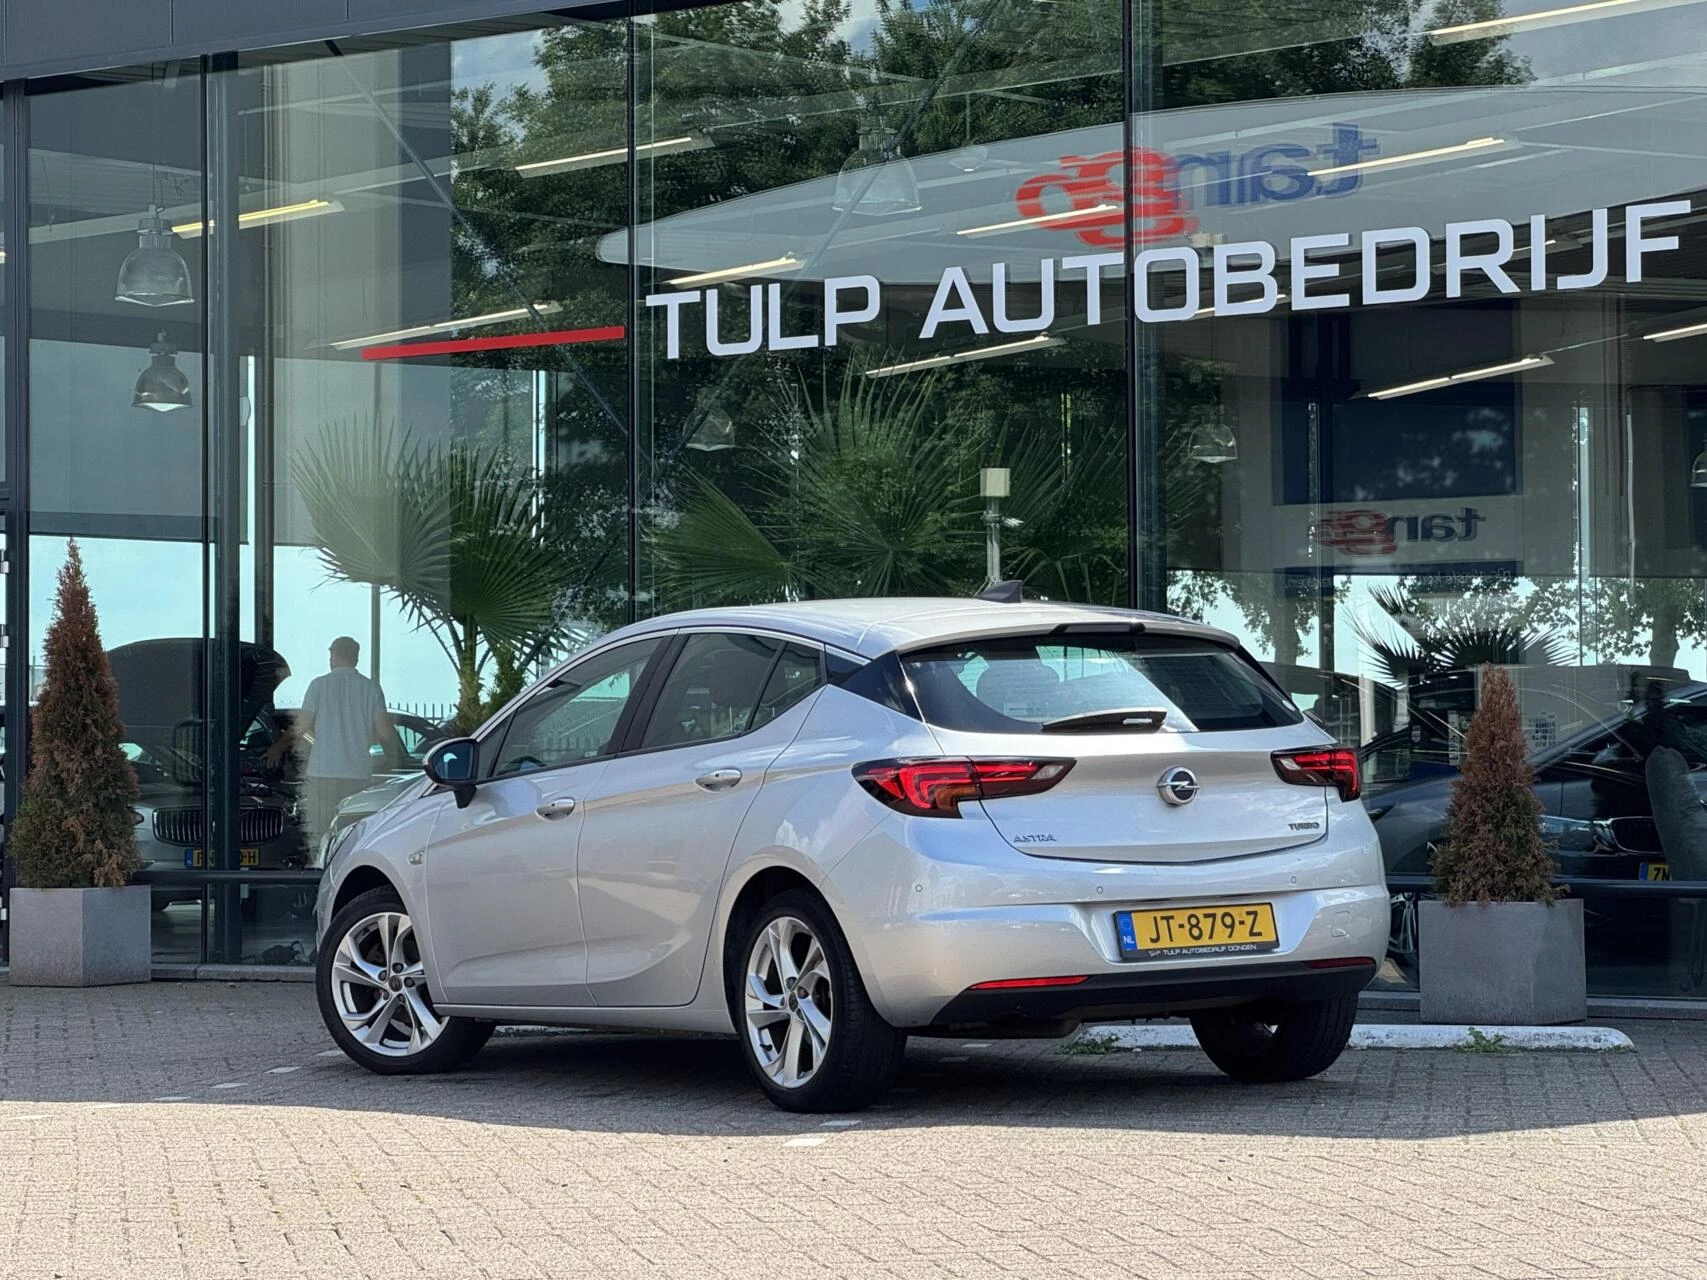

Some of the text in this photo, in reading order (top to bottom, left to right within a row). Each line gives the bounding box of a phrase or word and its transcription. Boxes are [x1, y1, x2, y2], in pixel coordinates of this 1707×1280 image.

[646, 200, 1691, 360] TULP AUTOBEDRIJF
[1287, 821, 1320, 831] TURBO
[1013, 833, 1057, 843] ASTRA
[1149, 910, 1263, 944] JT-879-Z
[1123, 935, 1135, 944] NL
[1163, 948, 1180, 956] TULP
[1182, 945, 1226, 954] AUTOBEDRIJF
